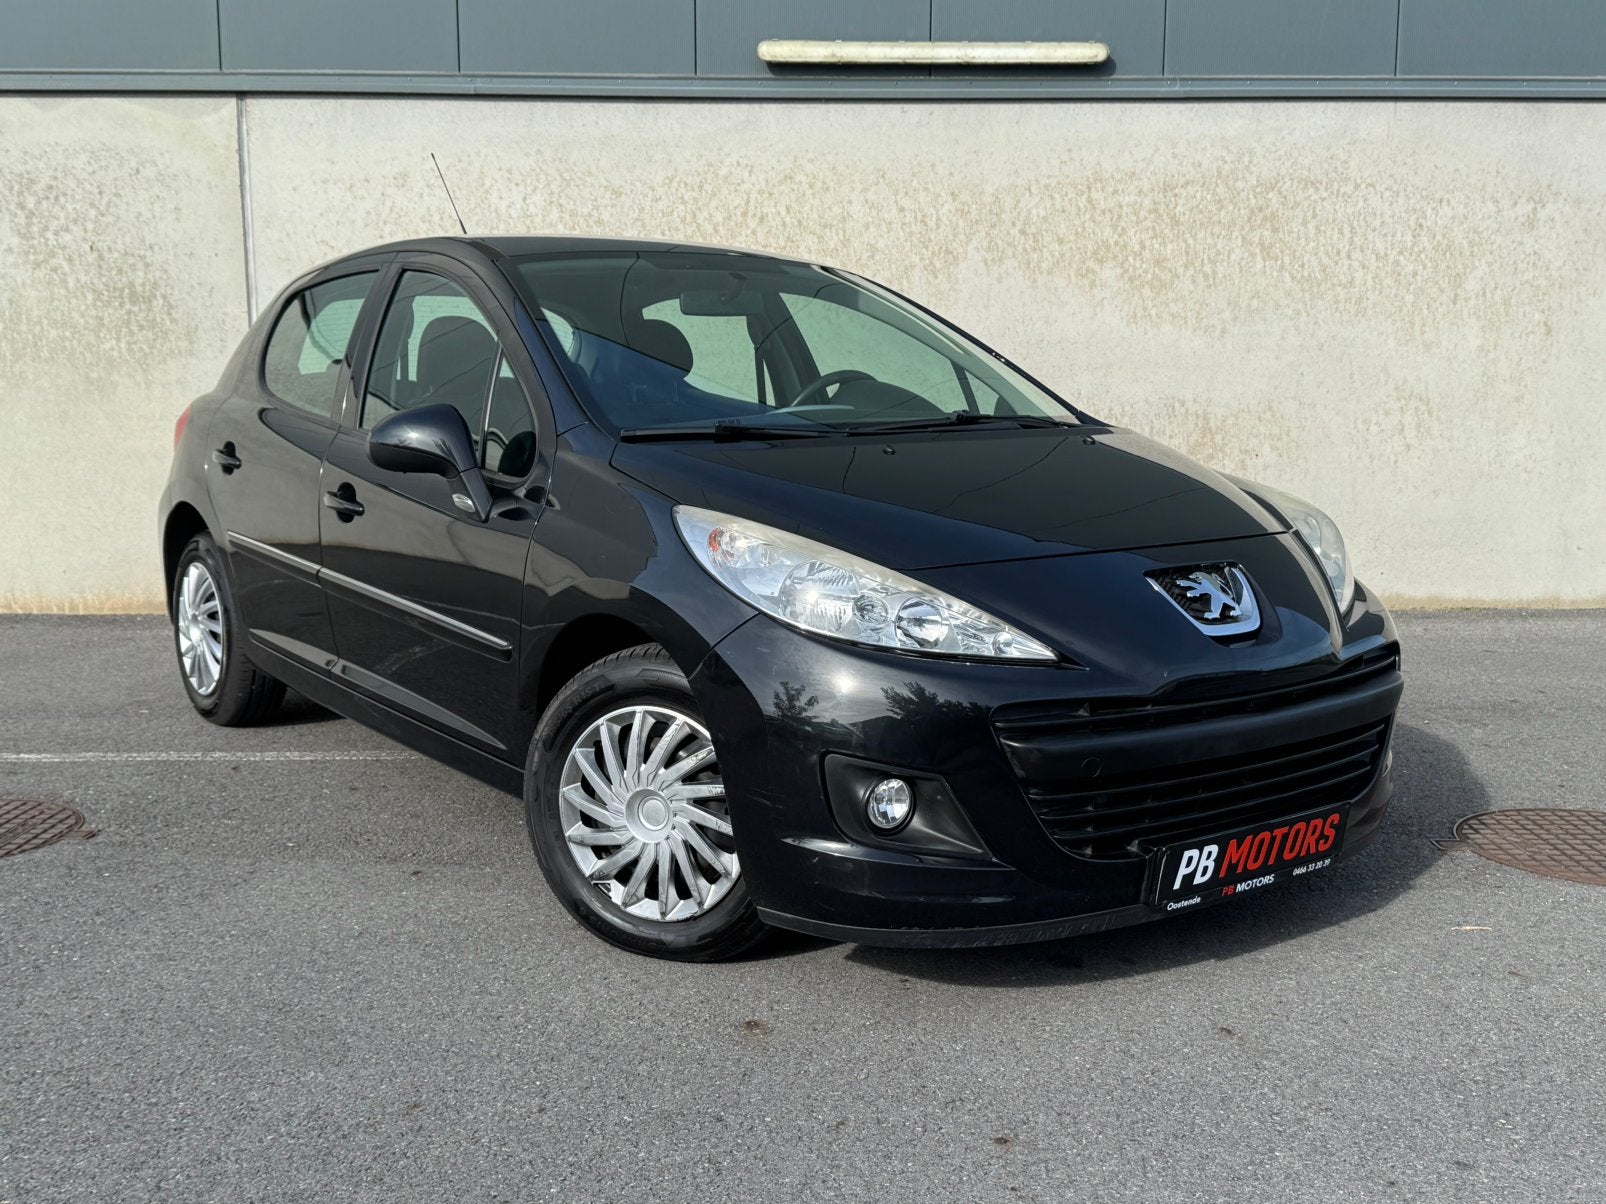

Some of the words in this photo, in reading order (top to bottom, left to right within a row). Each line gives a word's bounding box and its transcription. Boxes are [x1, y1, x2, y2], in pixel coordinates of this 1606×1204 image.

[1173, 844, 1218, 890] PB
[1218, 813, 1340, 878] MOTORS
[1292, 865, 1307, 876] 0466
[1221, 885, 1235, 897] PB
[1236, 874, 1275, 893] MOTORS
[1167, 896, 1201, 911] Oostende
